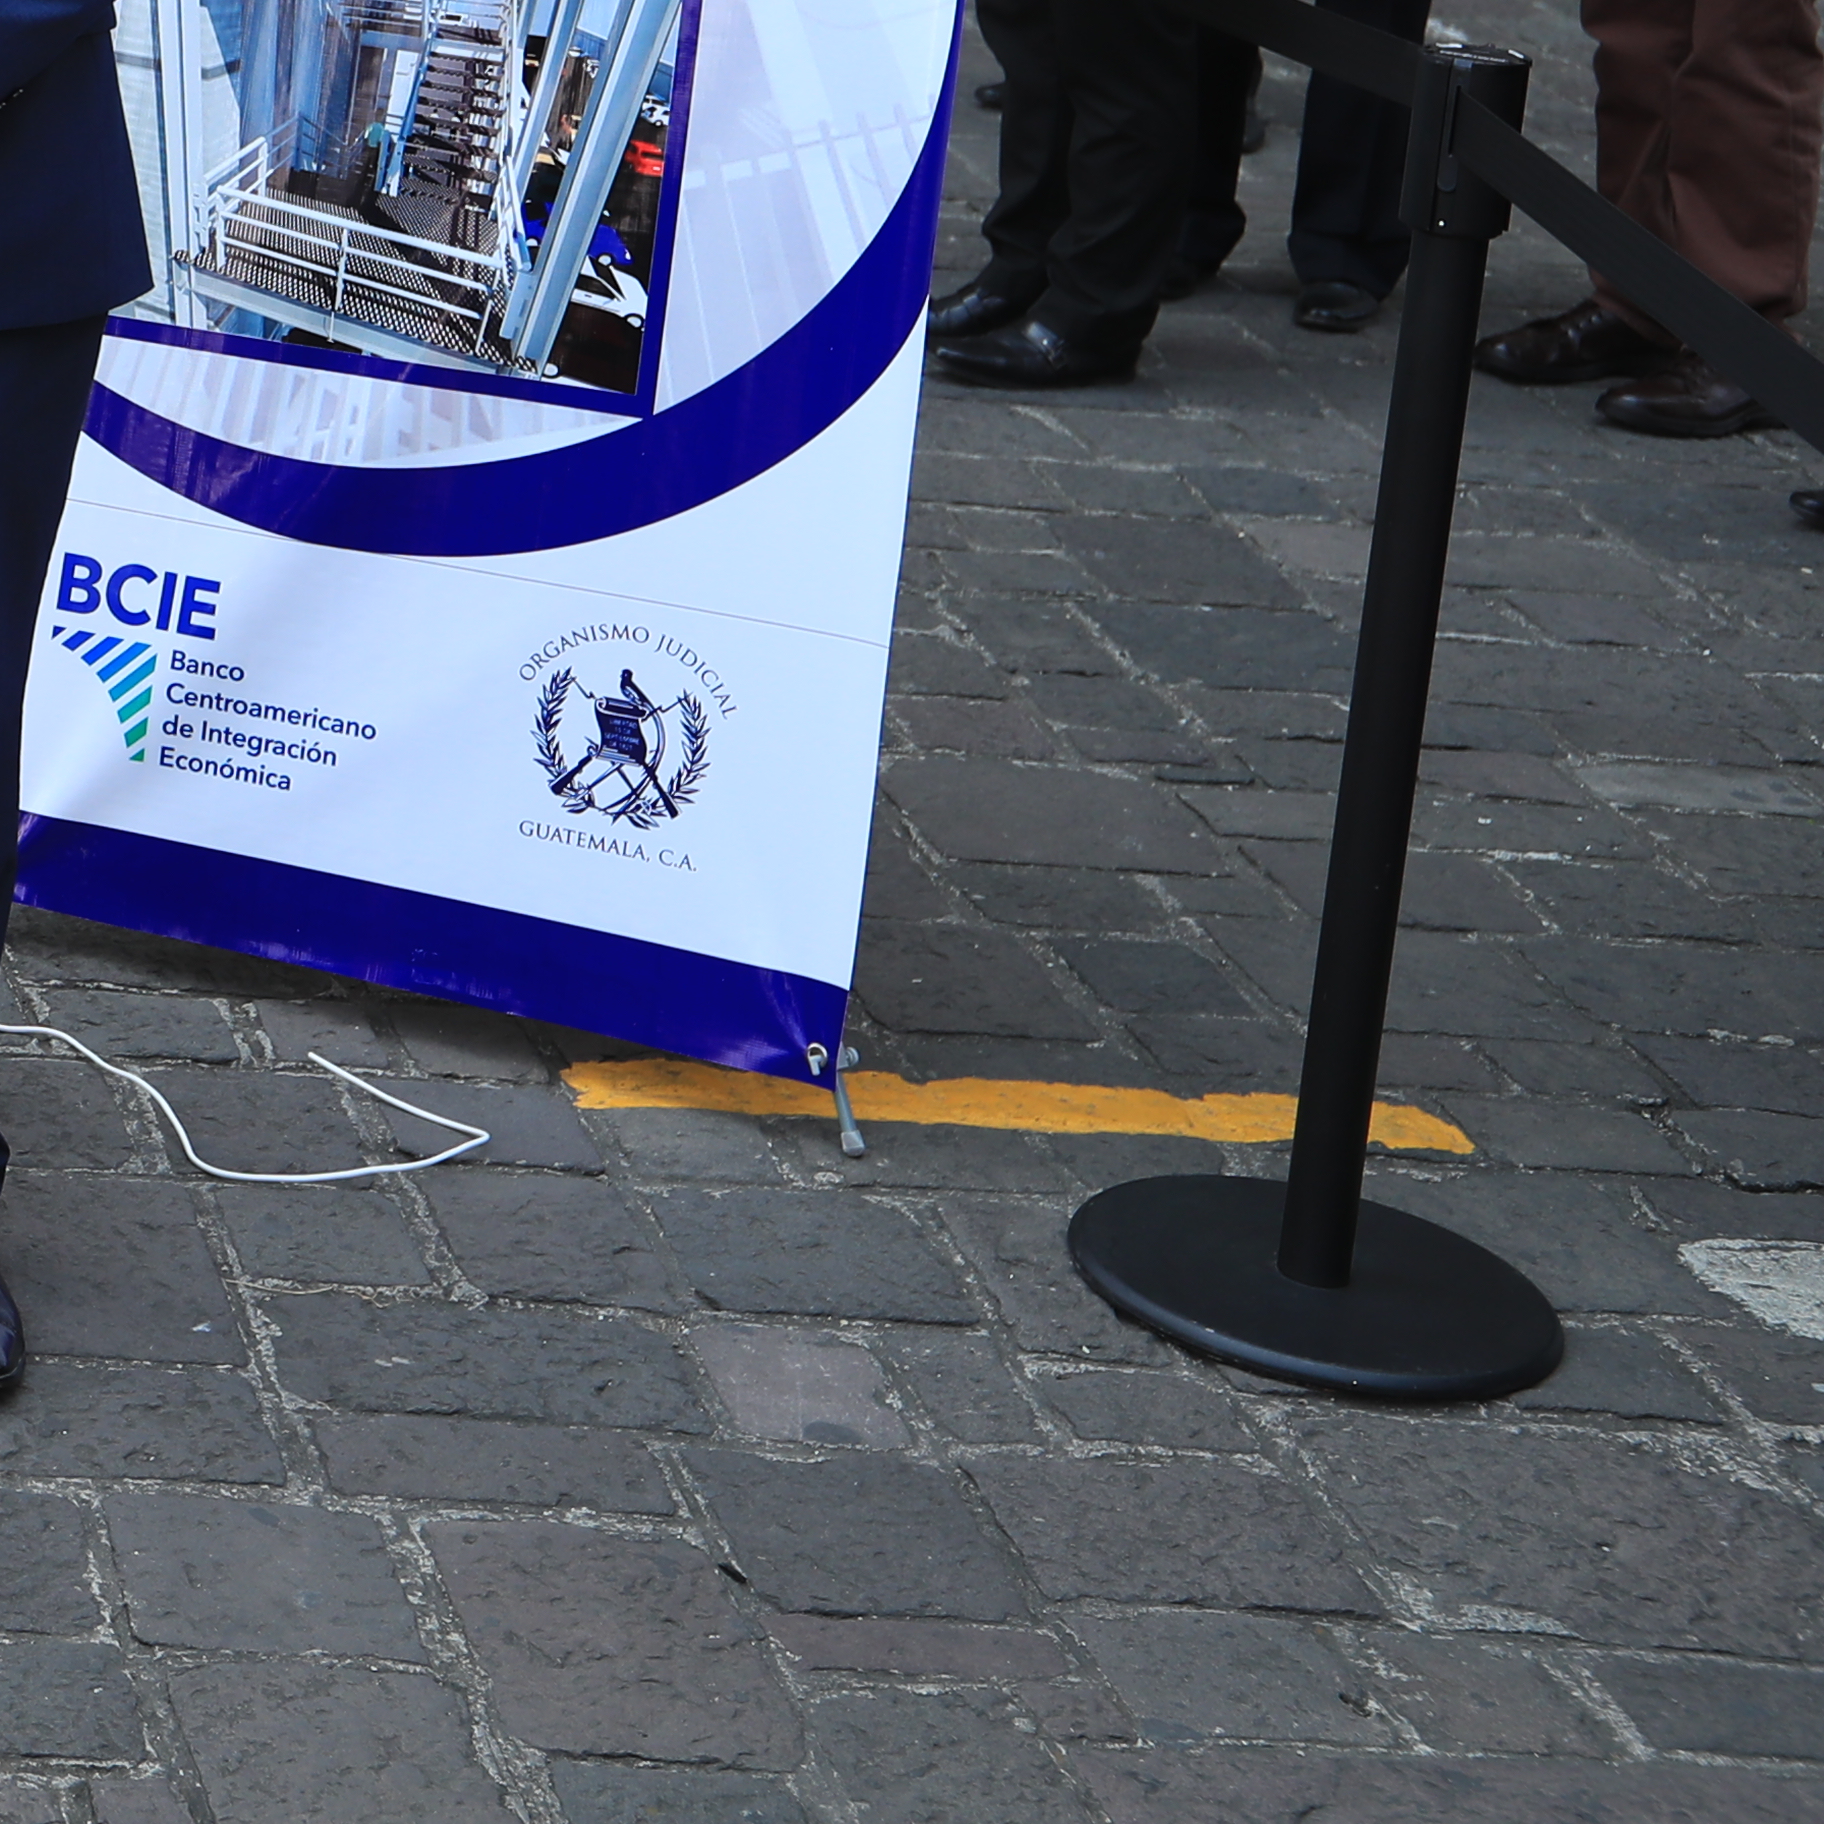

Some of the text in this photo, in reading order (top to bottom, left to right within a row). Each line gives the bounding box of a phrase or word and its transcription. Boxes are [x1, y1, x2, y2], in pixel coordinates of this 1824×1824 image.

[55, 552, 222, 641] BCIE
[169, 650, 245, 684] Banco
[519, 623, 739, 719] ORGANISMO JUDICIAL
[165, 683, 378, 743] Centroamericano
[162, 714, 338, 767] de Integración
[158, 745, 292, 791] Económica
[519, 820, 697, 872] GUATEMALA, C.A.
